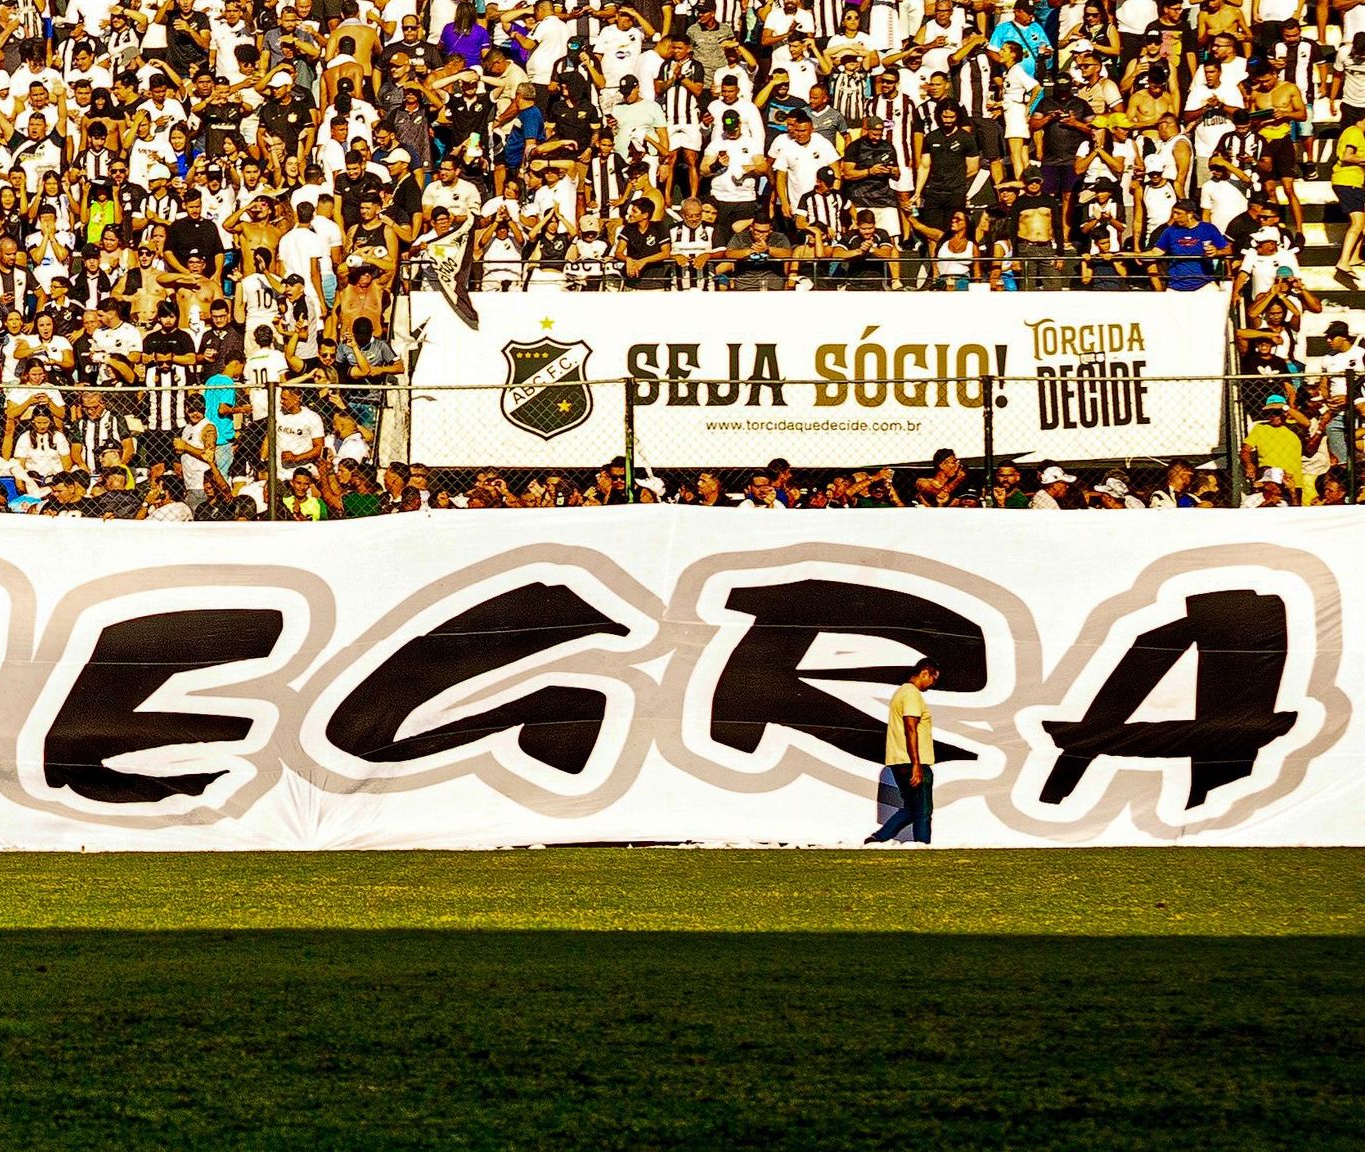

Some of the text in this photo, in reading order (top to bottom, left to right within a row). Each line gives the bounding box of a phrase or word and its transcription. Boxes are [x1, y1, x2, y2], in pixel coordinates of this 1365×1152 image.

[256, 288, 273, 309] 10
[1024, 319, 1145, 361] TORCIDA
[627, 325, 1009, 409] SEJA SÓCIO!
[510, 374, 547, 406] ABC
[1037, 359, 1150, 431] DECIDE
[706, 418, 922, 433] www.torcidaquedecide.com.br
